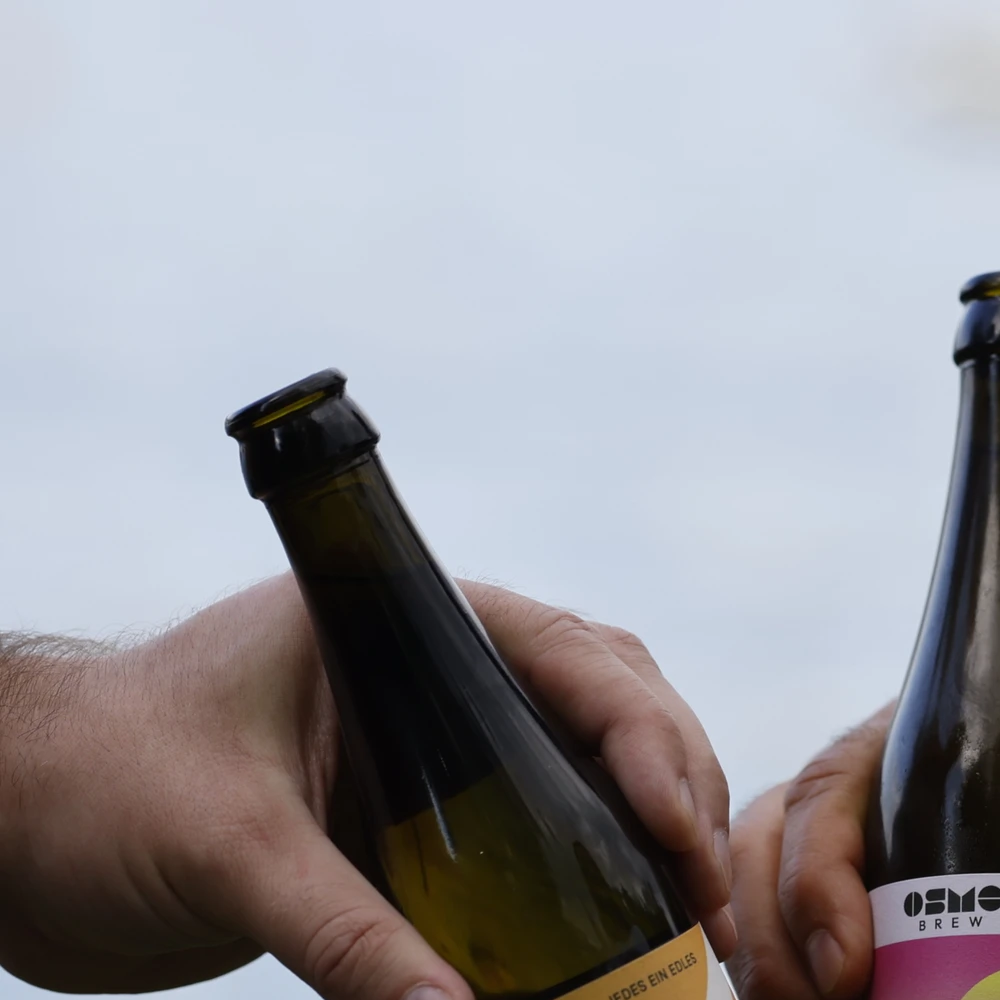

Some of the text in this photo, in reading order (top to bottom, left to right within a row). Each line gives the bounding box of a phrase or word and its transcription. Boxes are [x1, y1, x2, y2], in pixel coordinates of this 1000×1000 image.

[918, 915, 983, 932] BREW
[647, 967, 669, 987] EIN
[667, 952, 698, 977] EDLES
